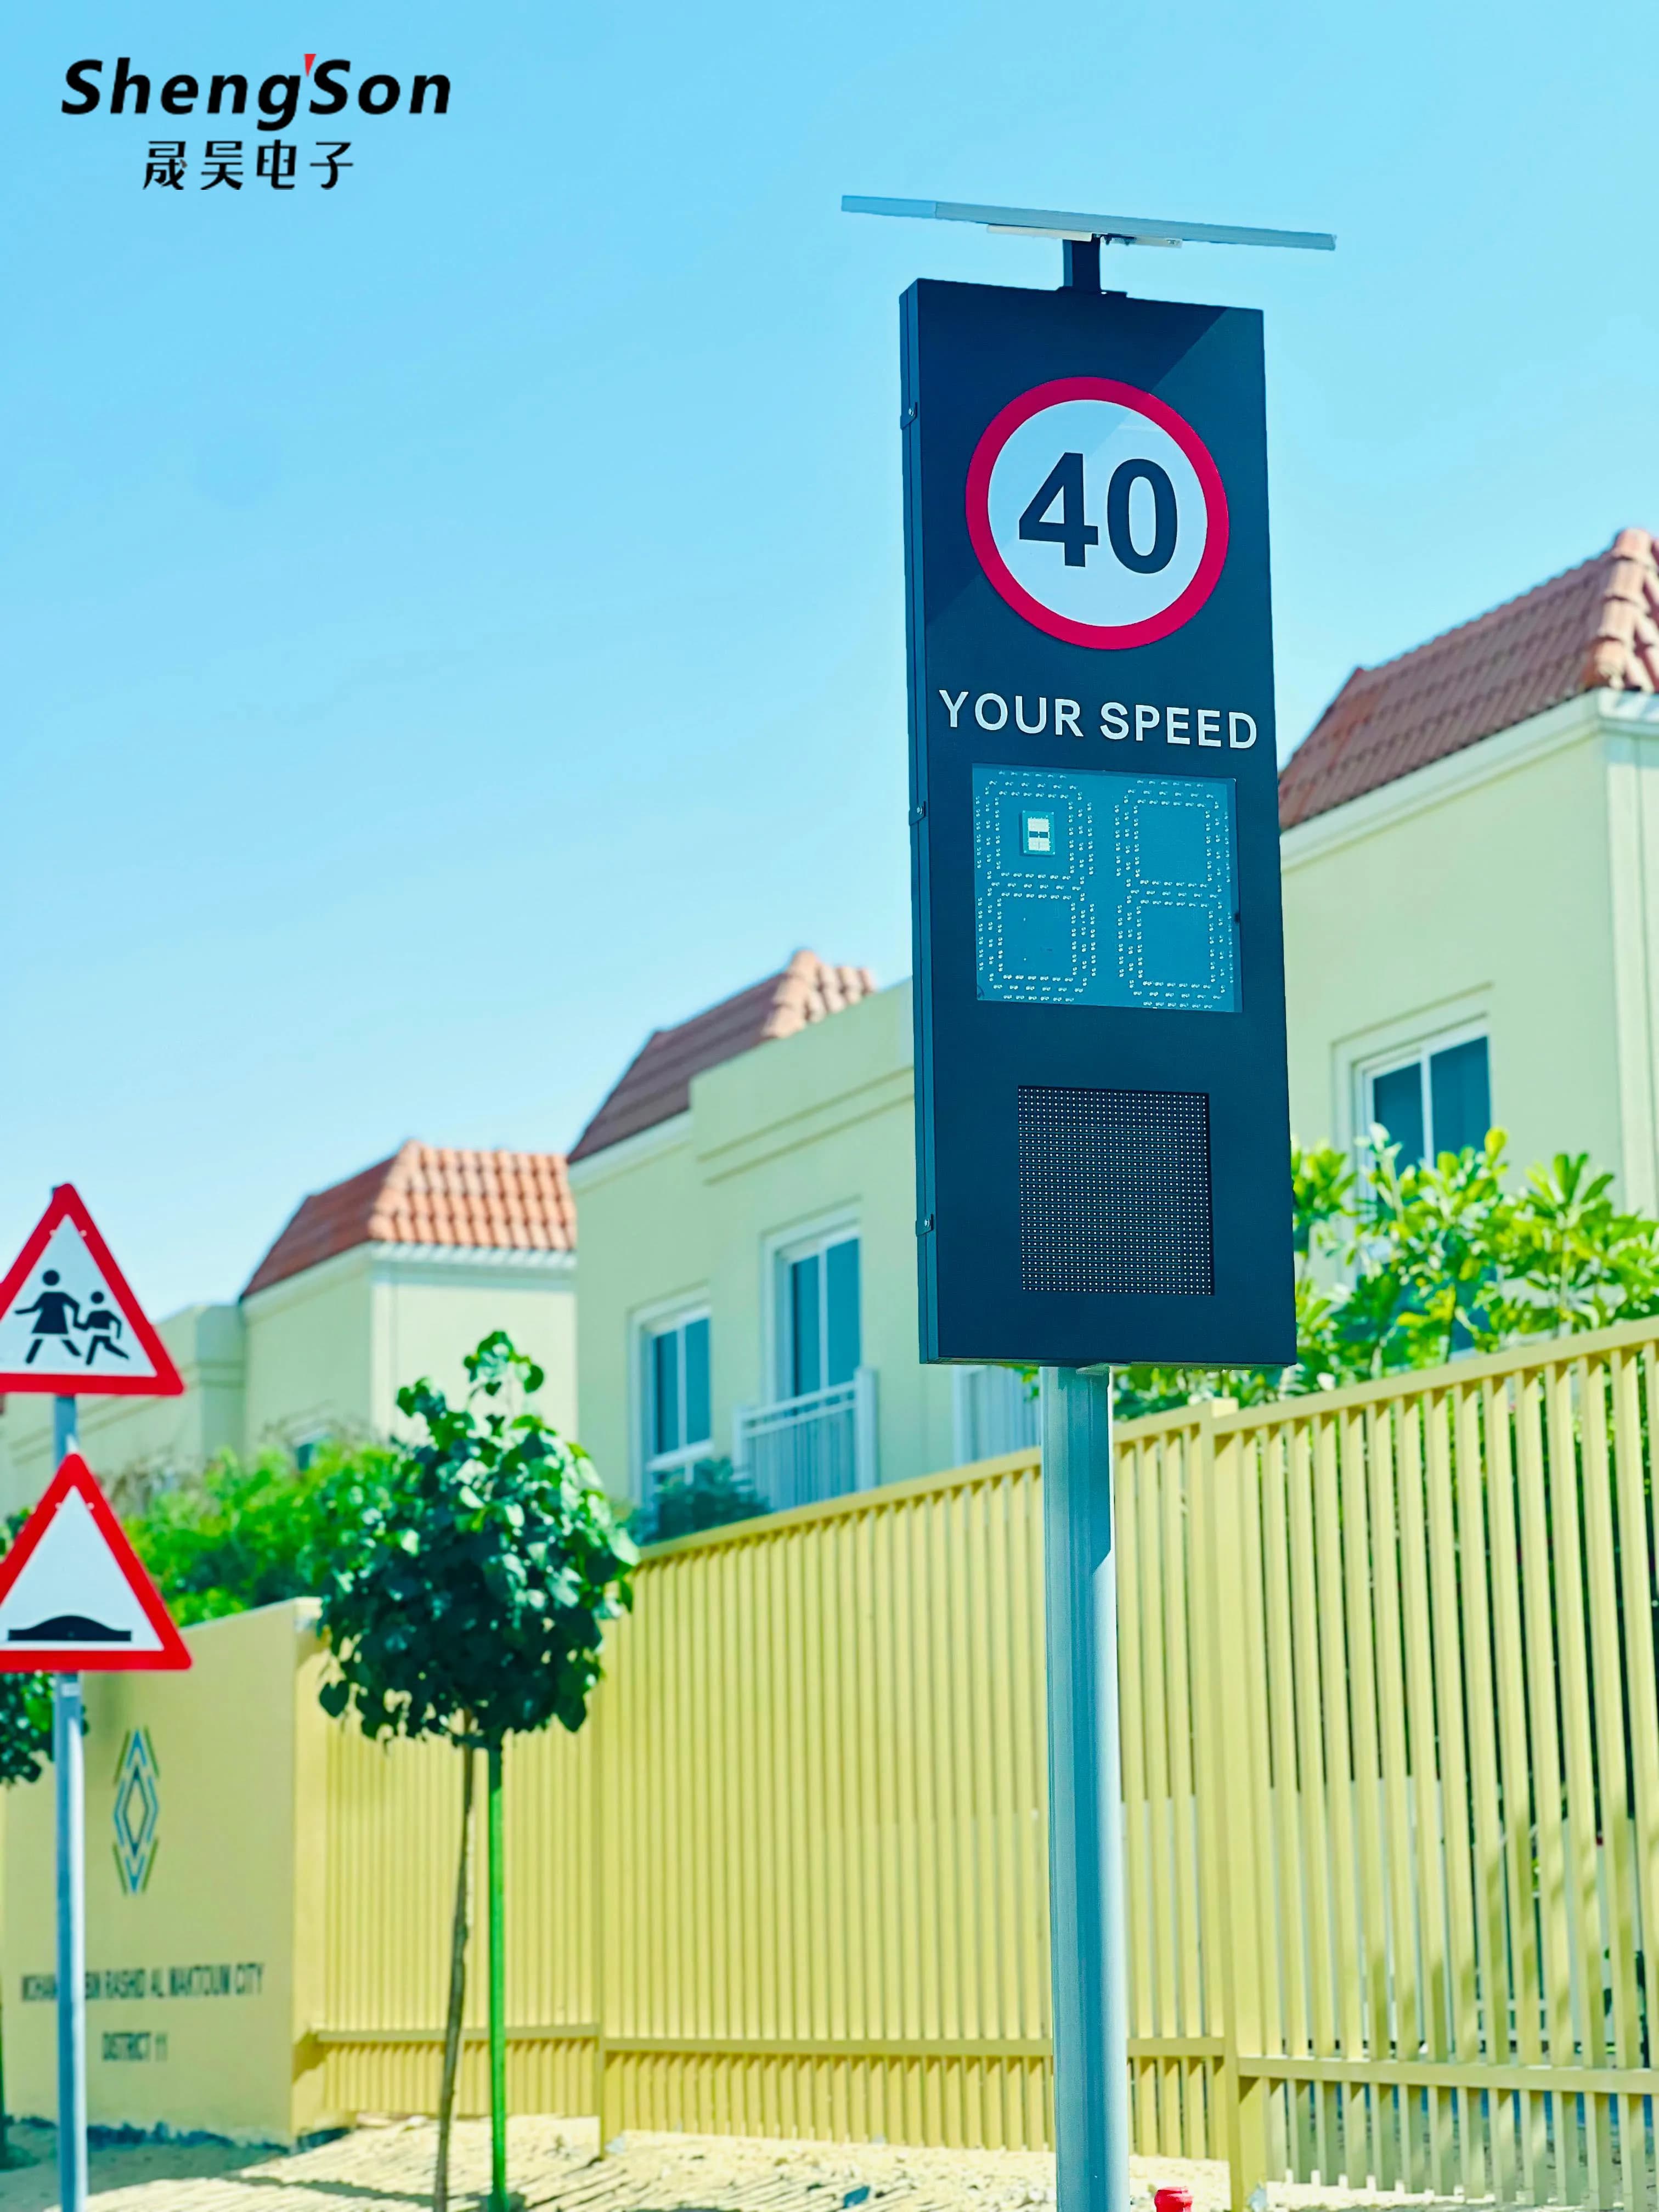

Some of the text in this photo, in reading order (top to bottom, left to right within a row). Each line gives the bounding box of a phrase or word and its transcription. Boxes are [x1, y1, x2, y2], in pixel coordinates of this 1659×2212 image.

[1019, 452, 1177, 574] 40
[939, 690, 1257, 748] YOUR SPEED
[236, 1963, 263, 1995] CITY
